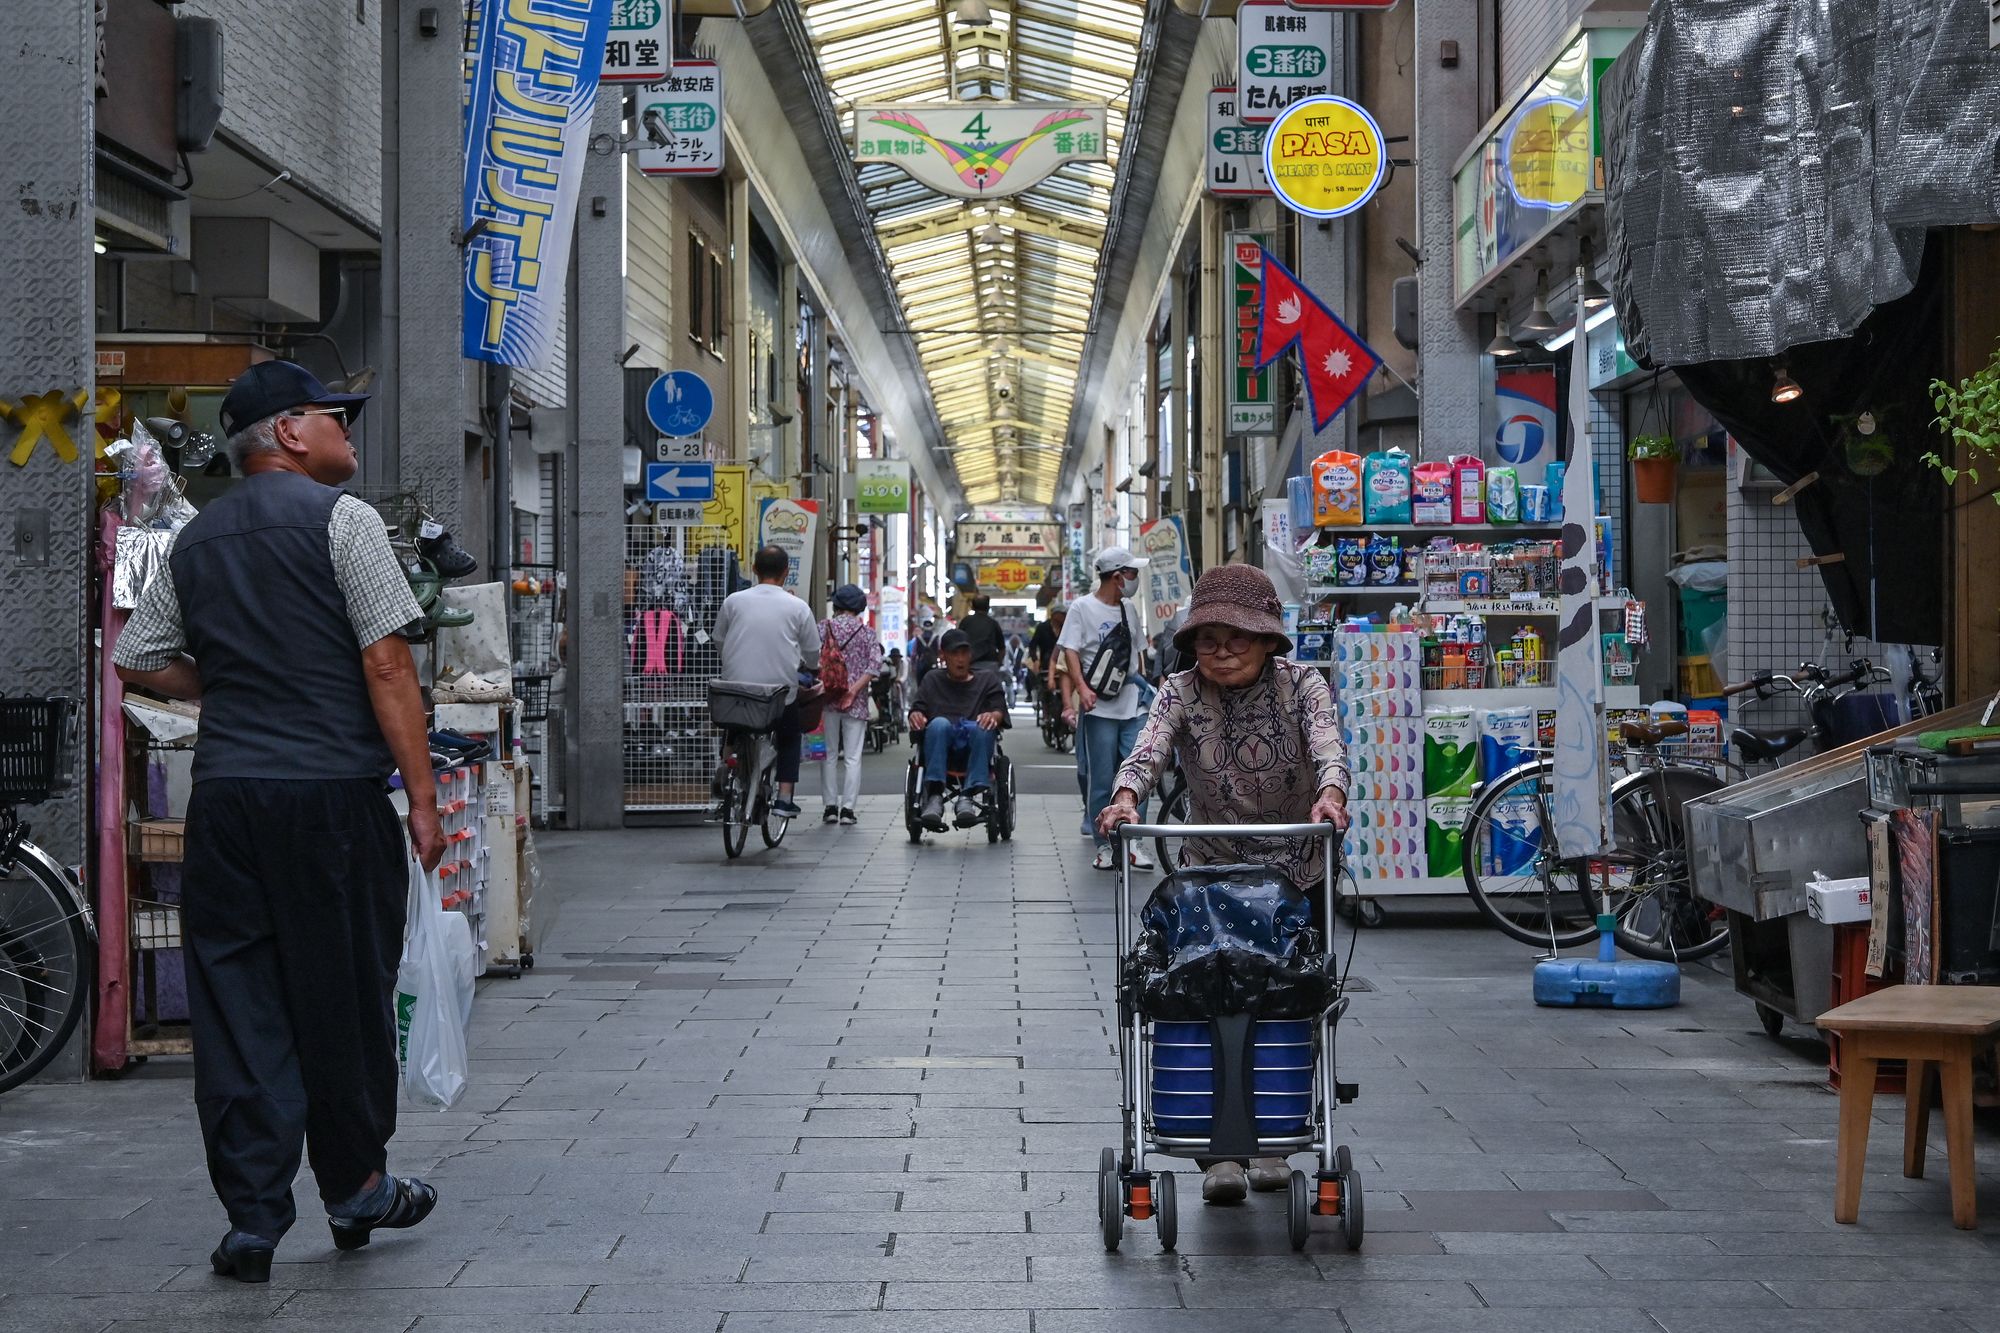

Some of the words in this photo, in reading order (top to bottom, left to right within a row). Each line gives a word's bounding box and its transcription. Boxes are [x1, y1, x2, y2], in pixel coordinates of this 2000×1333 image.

[1265, 16, 1307, 32] 肌着専科
[1253, 49, 1321, 74] 3番街
[960, 111, 992, 140] 4
[1304, 116, 1331, 128] पासा
[651, 138, 704, 151] トラル
[860, 139, 928, 156] お買物は
[1053, 131, 1100, 155] 番街
[1281, 130, 1371, 158] PASA
[665, 150, 714, 163] ガーデン
[1277, 164, 1319, 178] MEATS
[1322, 163, 1333, 177] &
[1336, 162, 1373, 176] MART
[1234, 412, 1273, 423] 太陽カメラ
[659, 508, 701, 520] 自転車を除く
[1429, 719, 1469, 729] エリエール
[1490, 719, 1529, 730] エリエール
